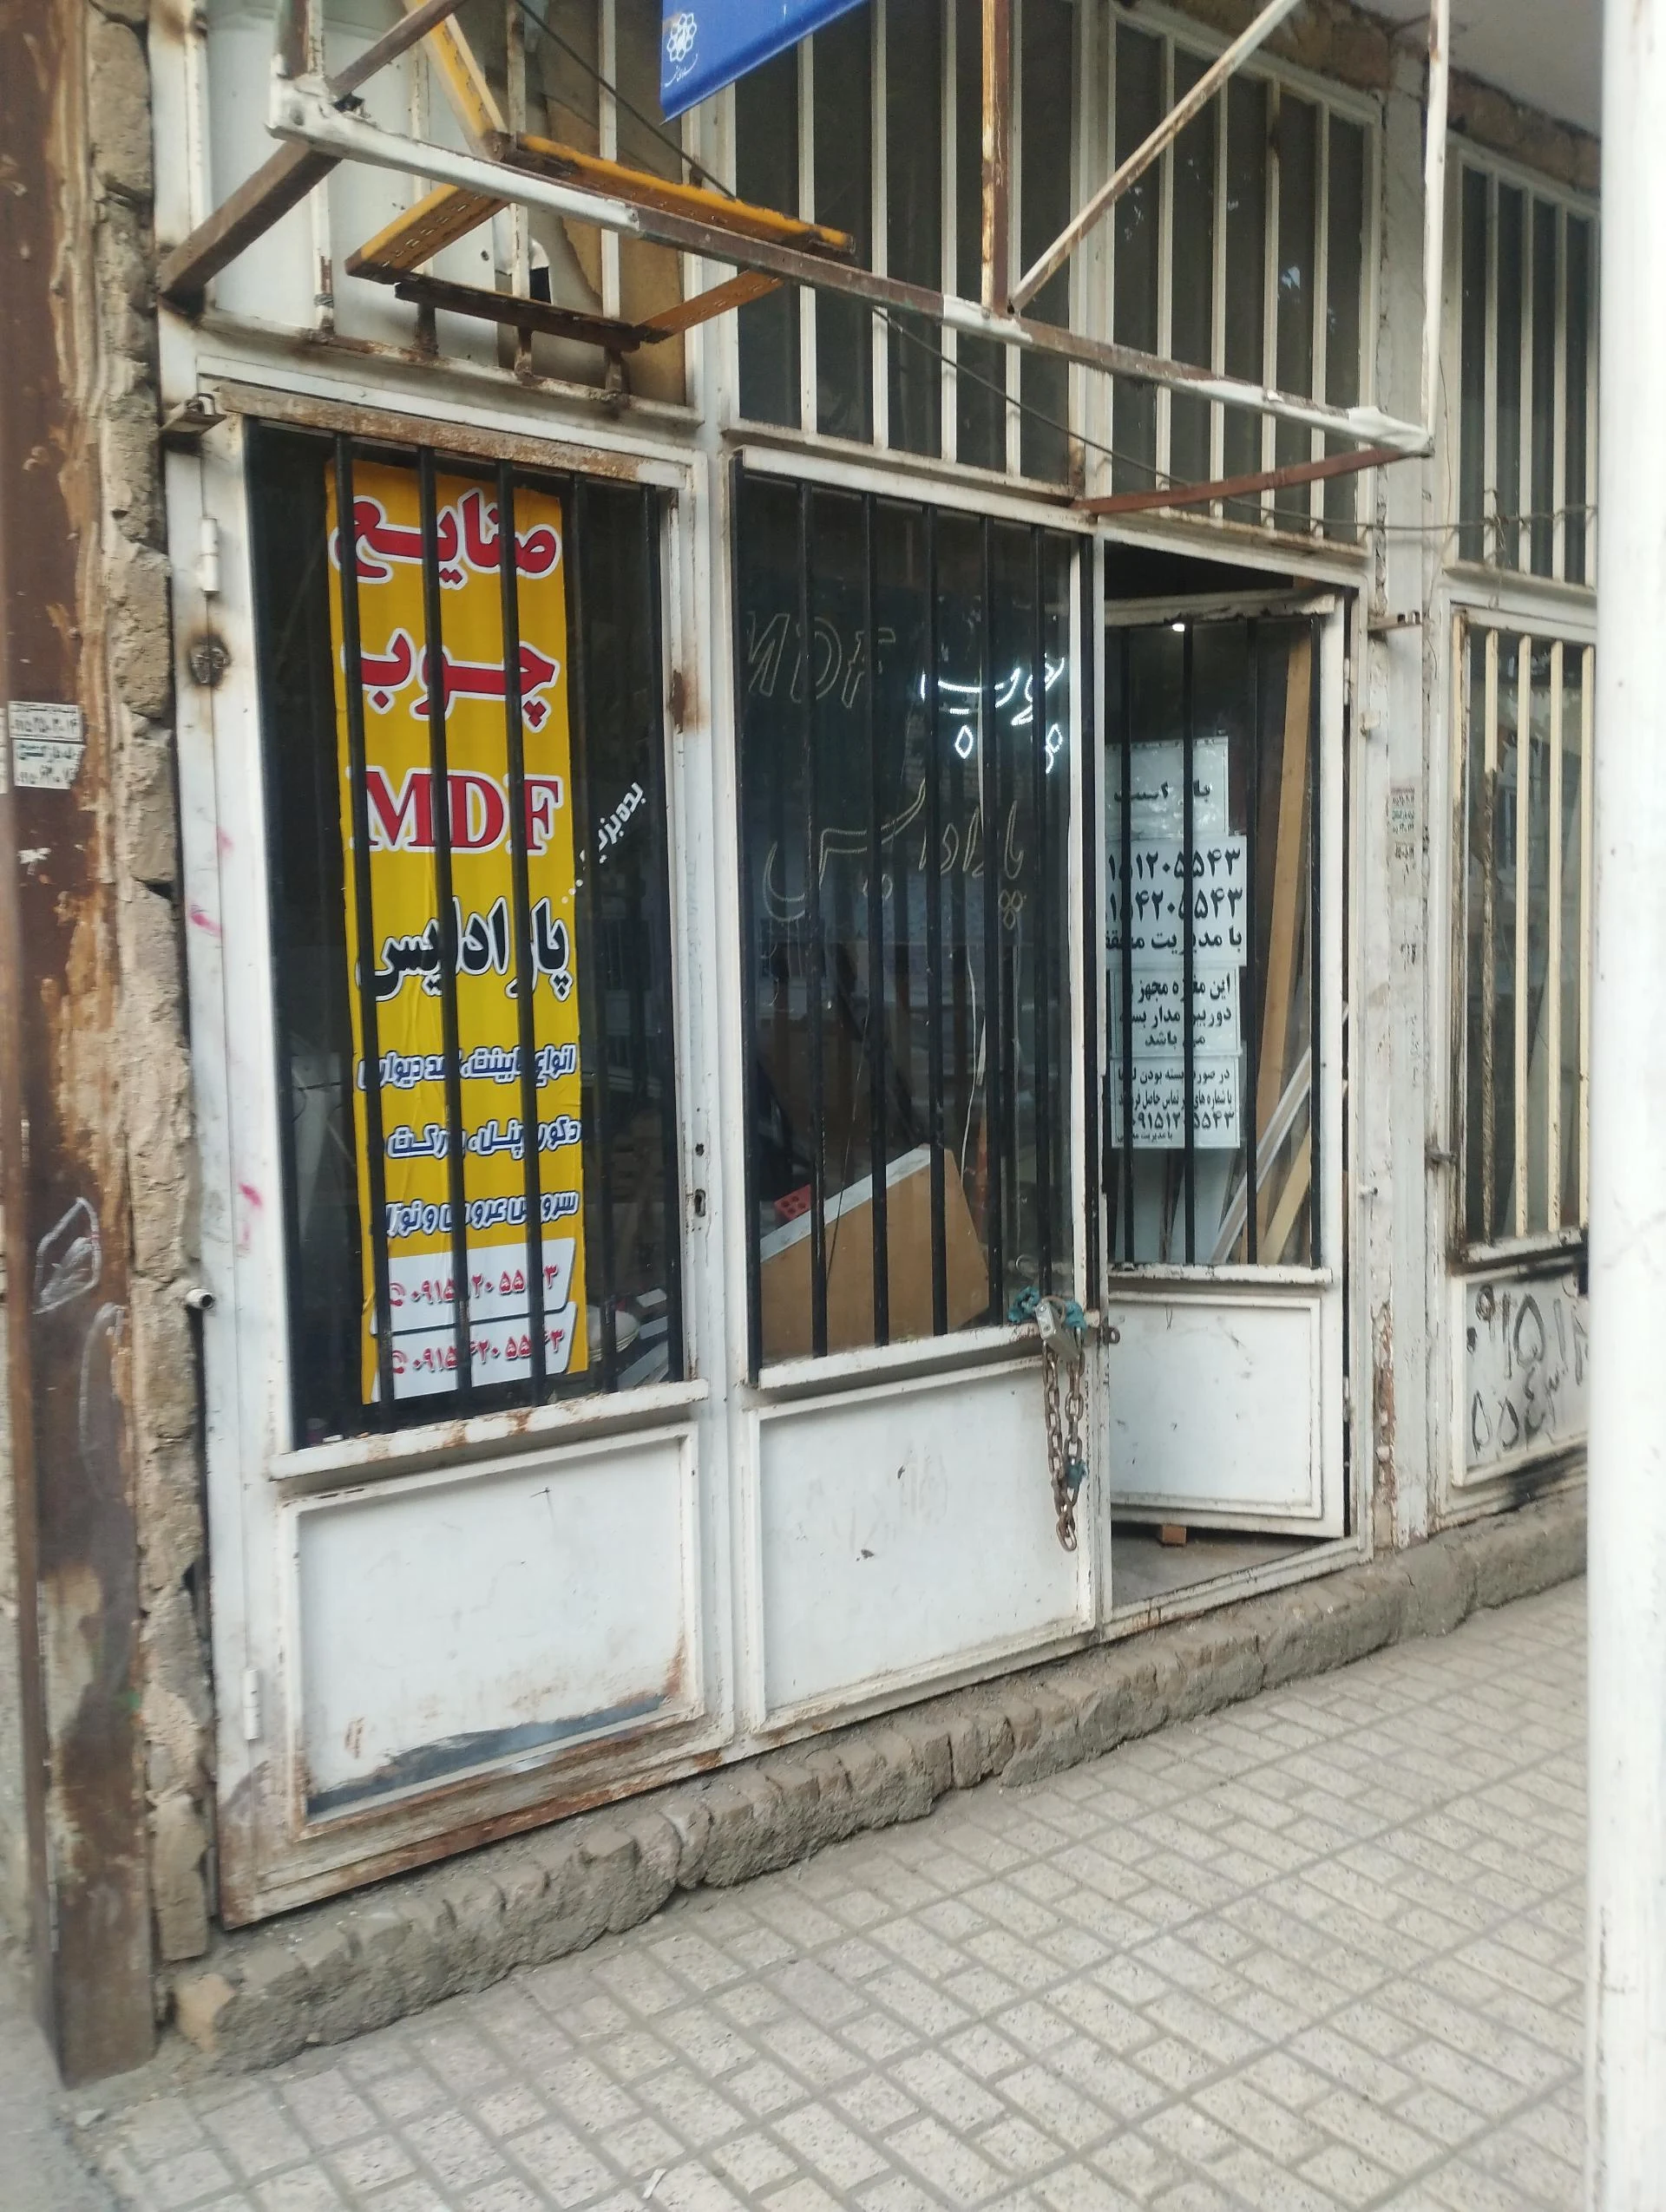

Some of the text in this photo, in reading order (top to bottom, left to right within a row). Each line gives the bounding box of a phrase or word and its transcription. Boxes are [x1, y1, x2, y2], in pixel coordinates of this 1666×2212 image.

[329, 488, 561, 590] صنایع
[340, 627, 560, 732] چوب
[346, 768, 564, 855] MDF
[1228, 924, 1243, 953] با
[1137, 979, 1170, 1004] مجهز
[1171, 974, 1207, 1003] مغه
[1209, 972, 1231, 1001] این
[1151, 1005, 1182, 1030] مدار
[1192, 1006, 1233, 1028] دوربی
[1145, 1029, 1178, 1051] باشد
[531, 1043, 578, 1088] انواع
[1193, 1069, 1217, 1085] صور
[1218, 1067, 1231, 1085] در
[1131, 1110, 1236, 1131] ۰۹۱۵۱۲۵۵۴۳
[507, 1190, 580, 1226] سروس
